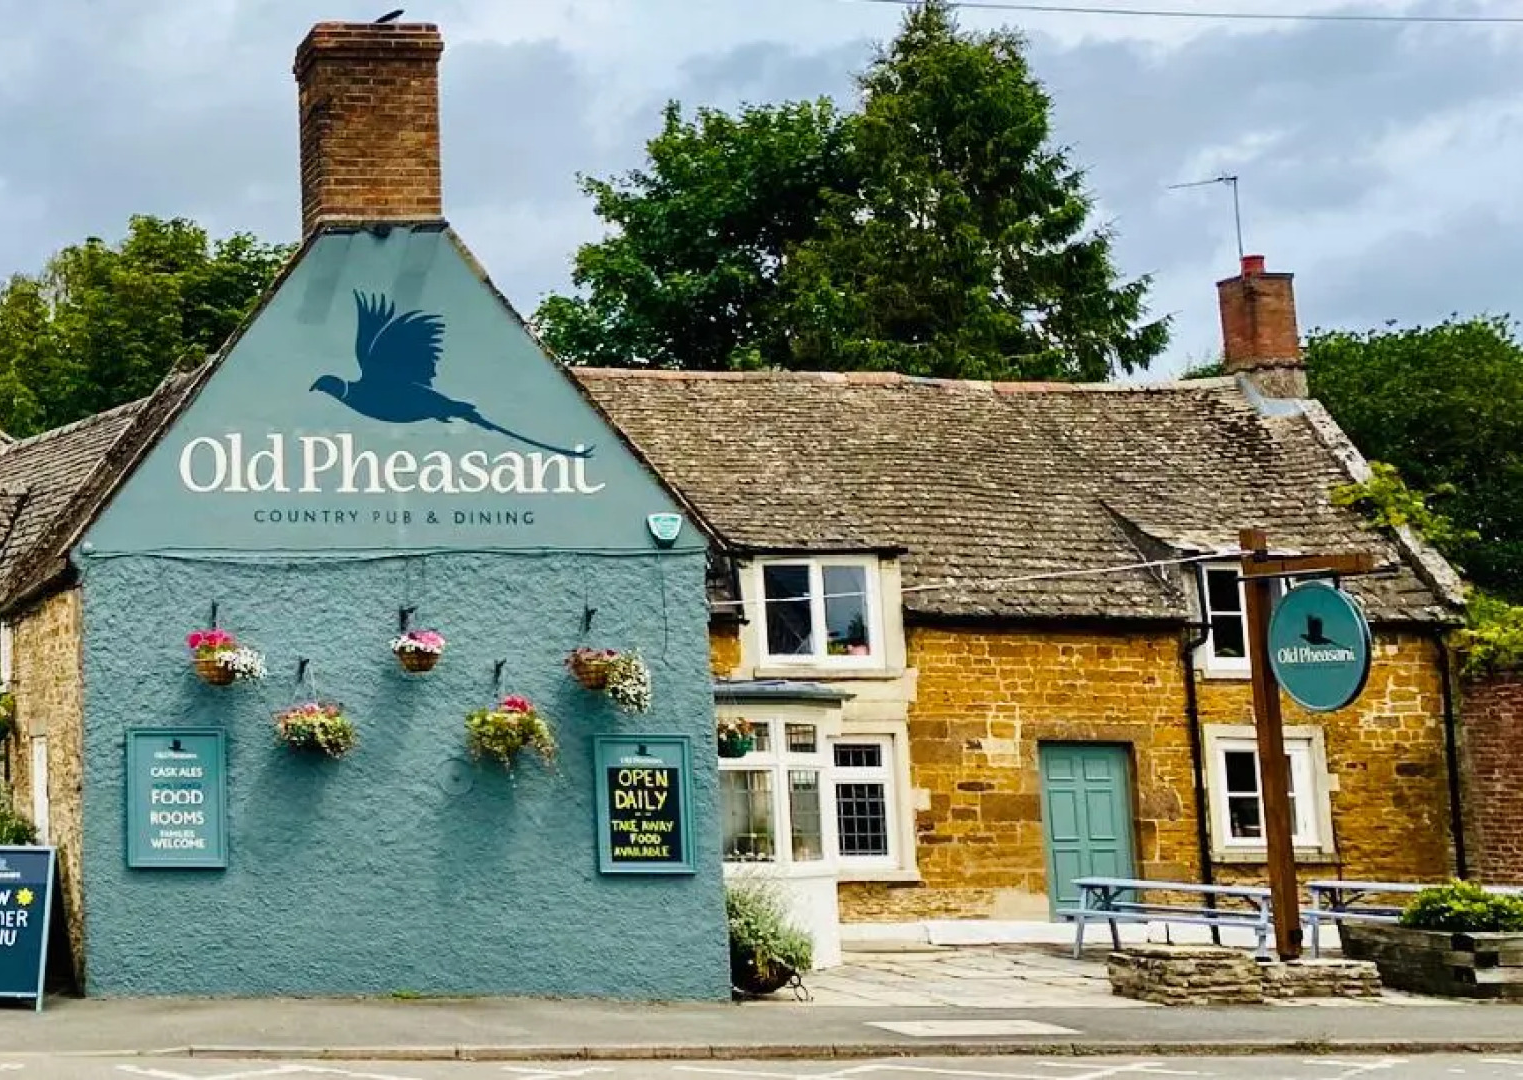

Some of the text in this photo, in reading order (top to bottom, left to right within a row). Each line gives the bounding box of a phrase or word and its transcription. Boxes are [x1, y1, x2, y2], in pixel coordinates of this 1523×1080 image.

[179, 433, 606, 494] Old Pheasant
[254, 510, 535, 525] COUNTRY PUB & DINING
[1278, 647, 1299, 663] Old
[150, 767, 203, 778] CASK ALES
[618, 769, 669, 787] OPEN
[151, 789, 204, 805] FOOD
[614, 790, 668, 810] DAILY
[150, 810, 205, 825] ROOMS
[611, 820, 674, 832] TAKE AWAY
[150, 838, 206, 849] WELCOME
[630, 832, 662, 844] FOOD
[613, 845, 671, 857] AVAILABLE
